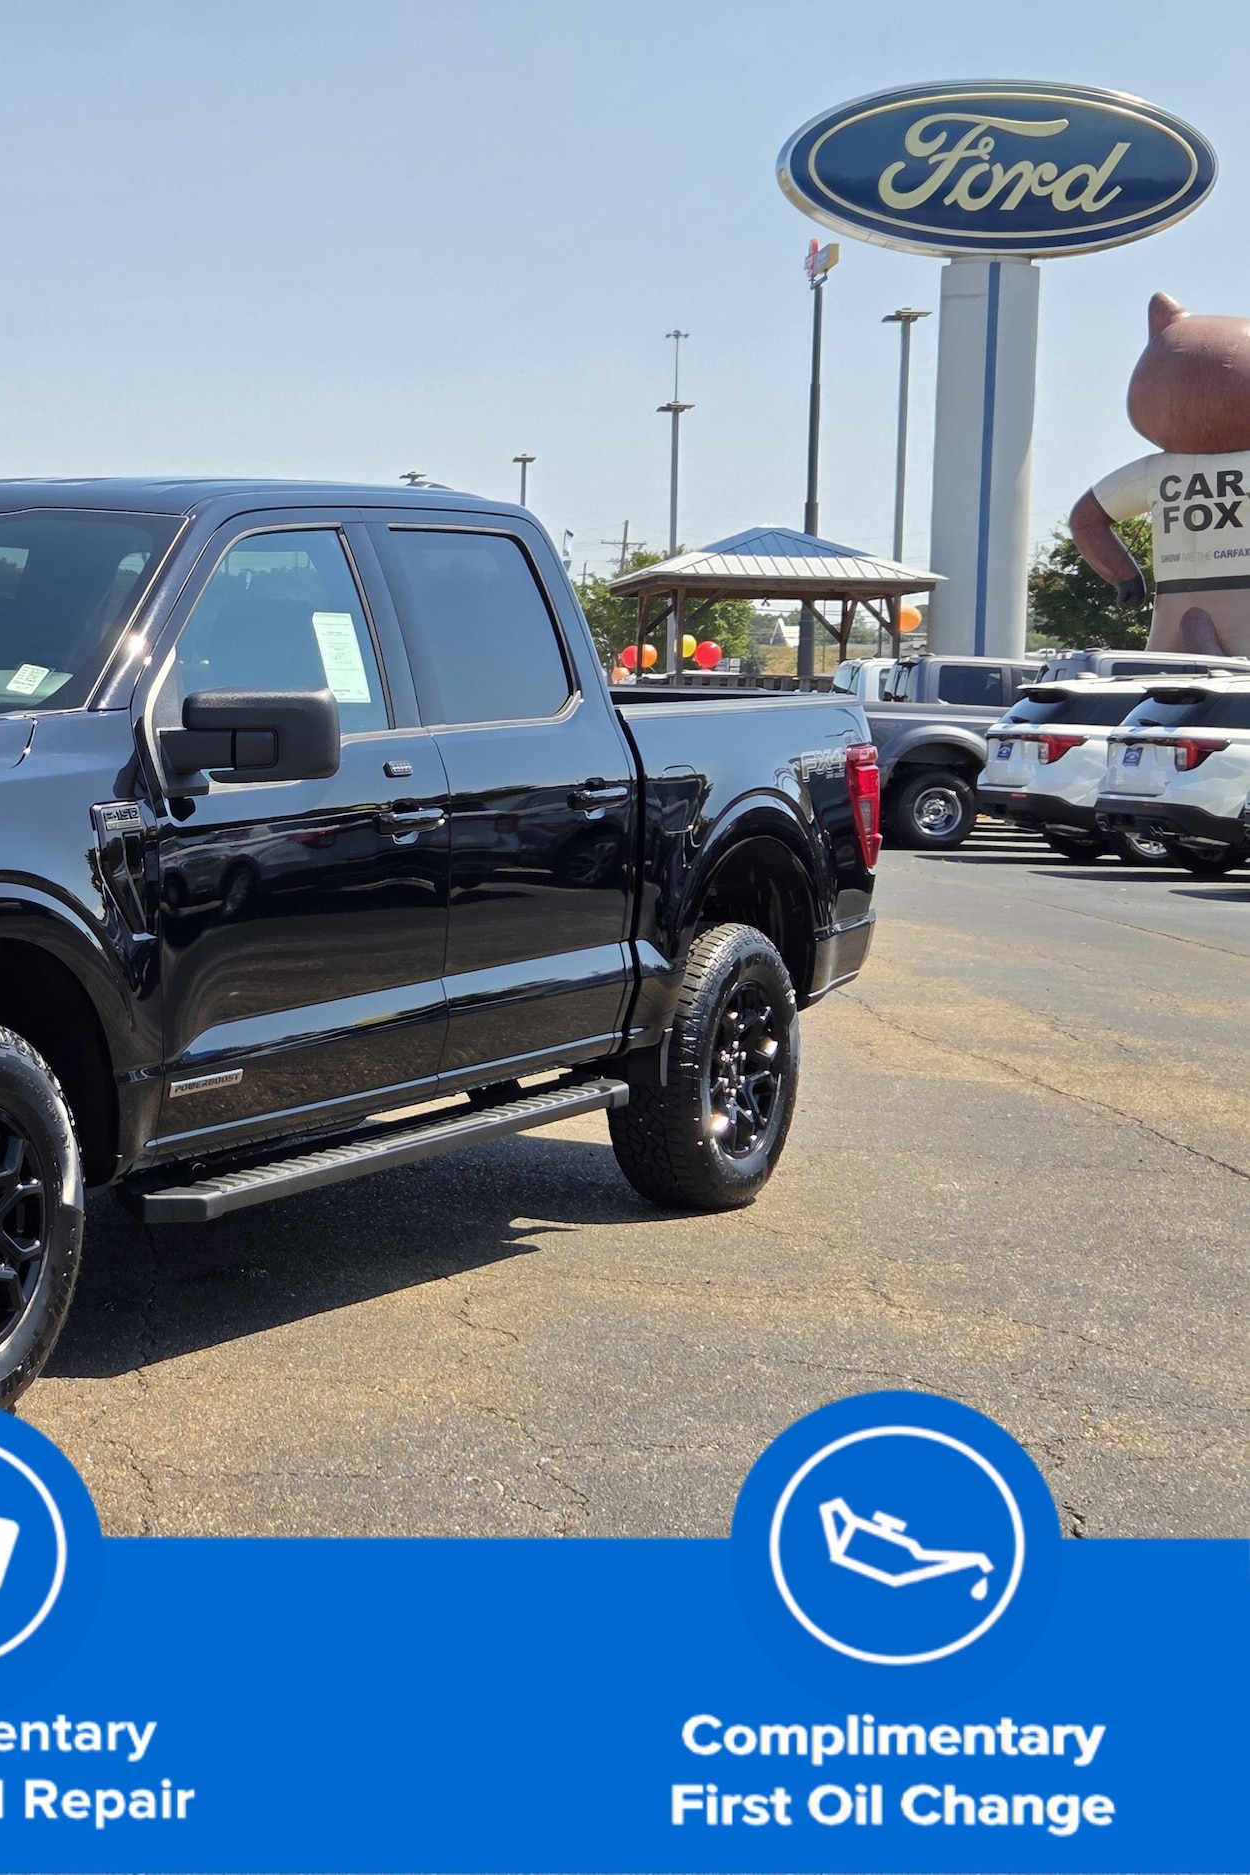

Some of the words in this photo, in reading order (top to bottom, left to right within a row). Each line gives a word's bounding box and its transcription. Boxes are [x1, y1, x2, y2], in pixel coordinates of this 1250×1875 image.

[878, 113, 1131, 212] Ford
[1159, 470, 1246, 502] CAR
[1163, 501, 1244, 534] FOX
[1161, 553, 1180, 563] SHOW
[1213, 547, 1250, 559] CARFAX
[801, 747, 846, 783] FX4
[174, 1074, 238, 1093] POWERBOOST
